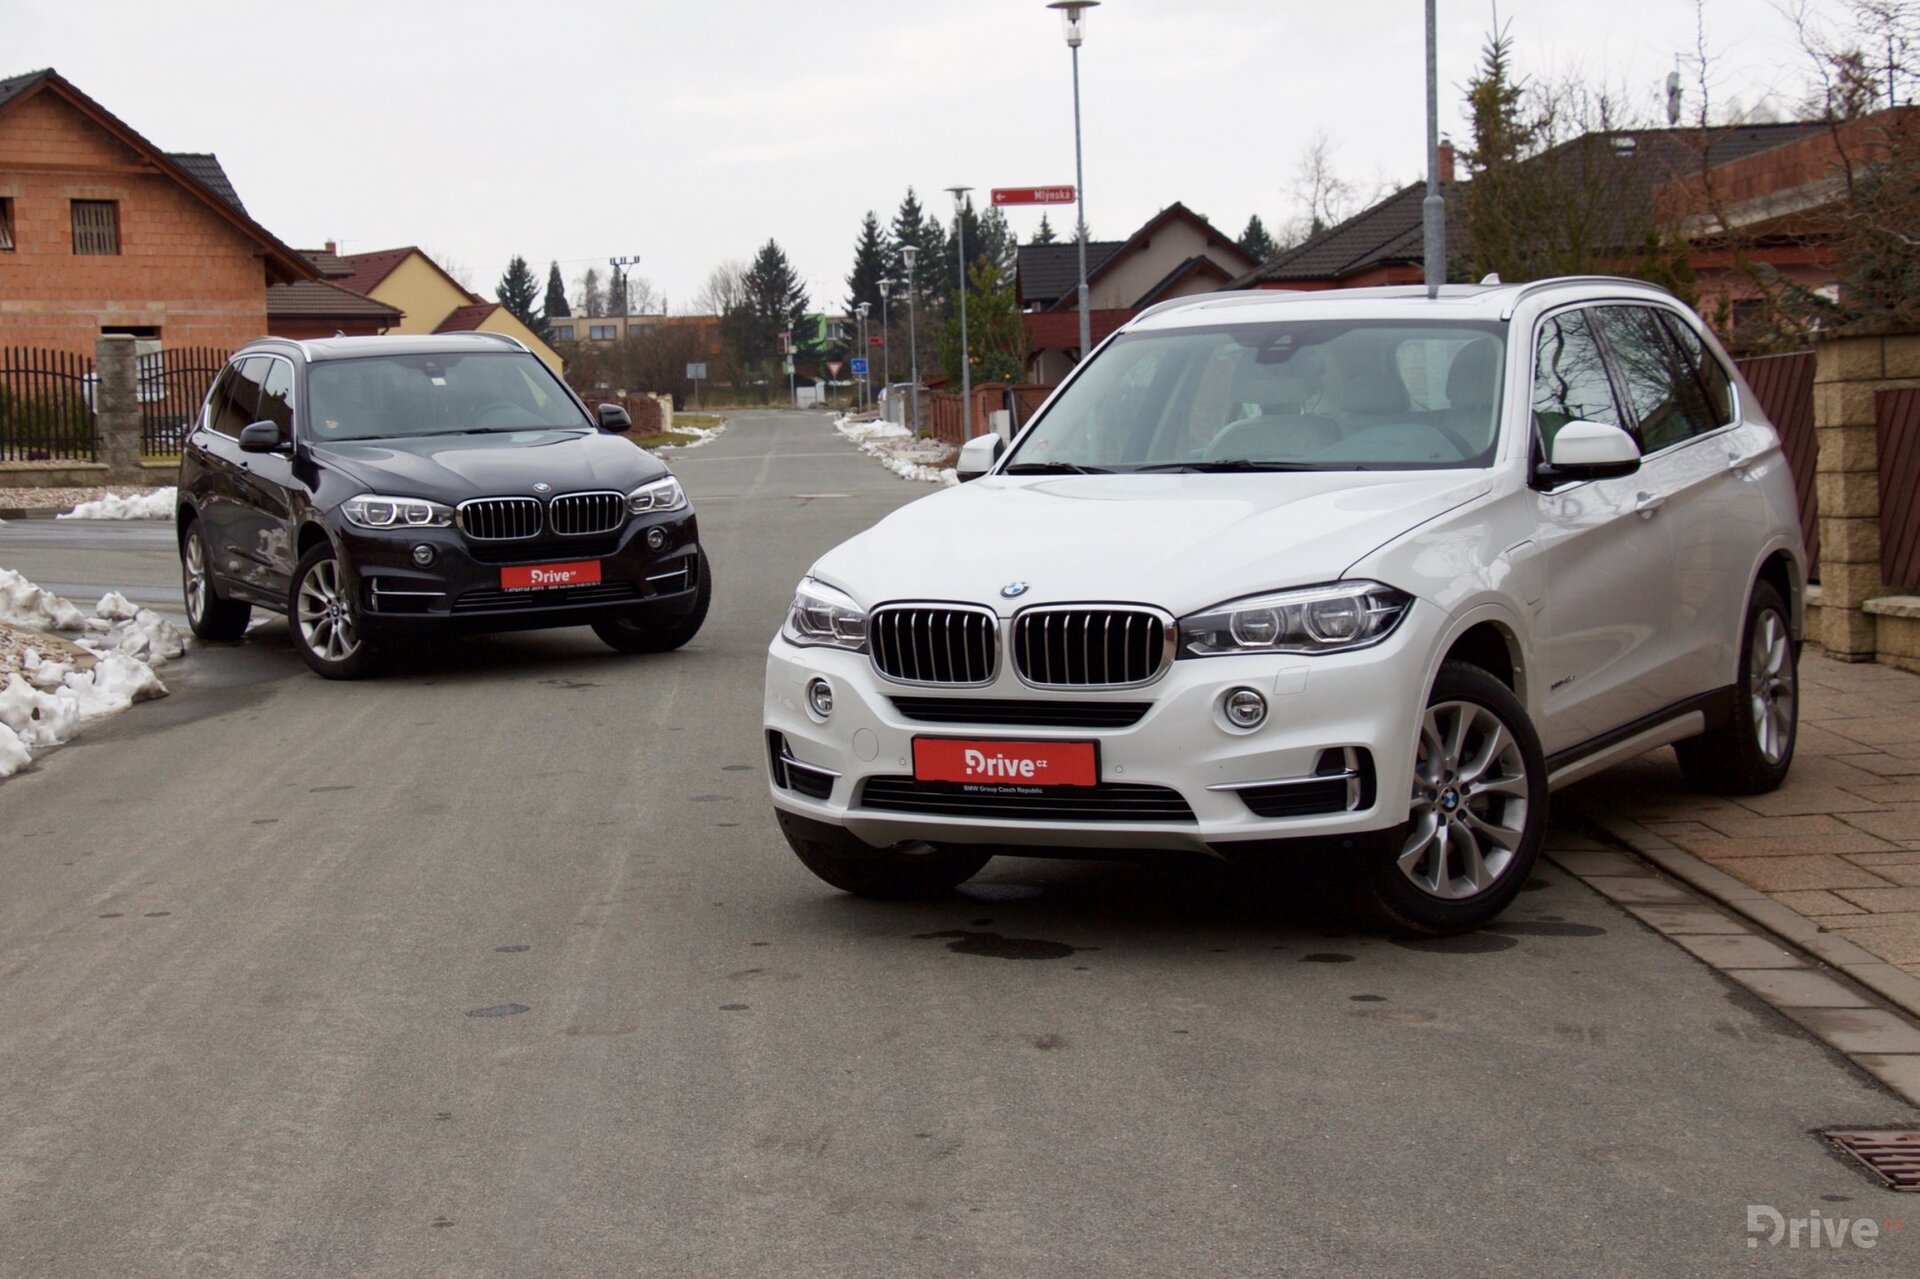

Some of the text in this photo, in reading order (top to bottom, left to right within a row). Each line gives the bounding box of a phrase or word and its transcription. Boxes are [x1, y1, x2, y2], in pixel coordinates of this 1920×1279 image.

[1034, 189, 1071, 202] Mlýnská
[531, 569, 570, 584] Drive
[965, 749, 1035, 777] Drive
[979, 785, 997, 793] Group
[1017, 786, 1044, 794] Republic
